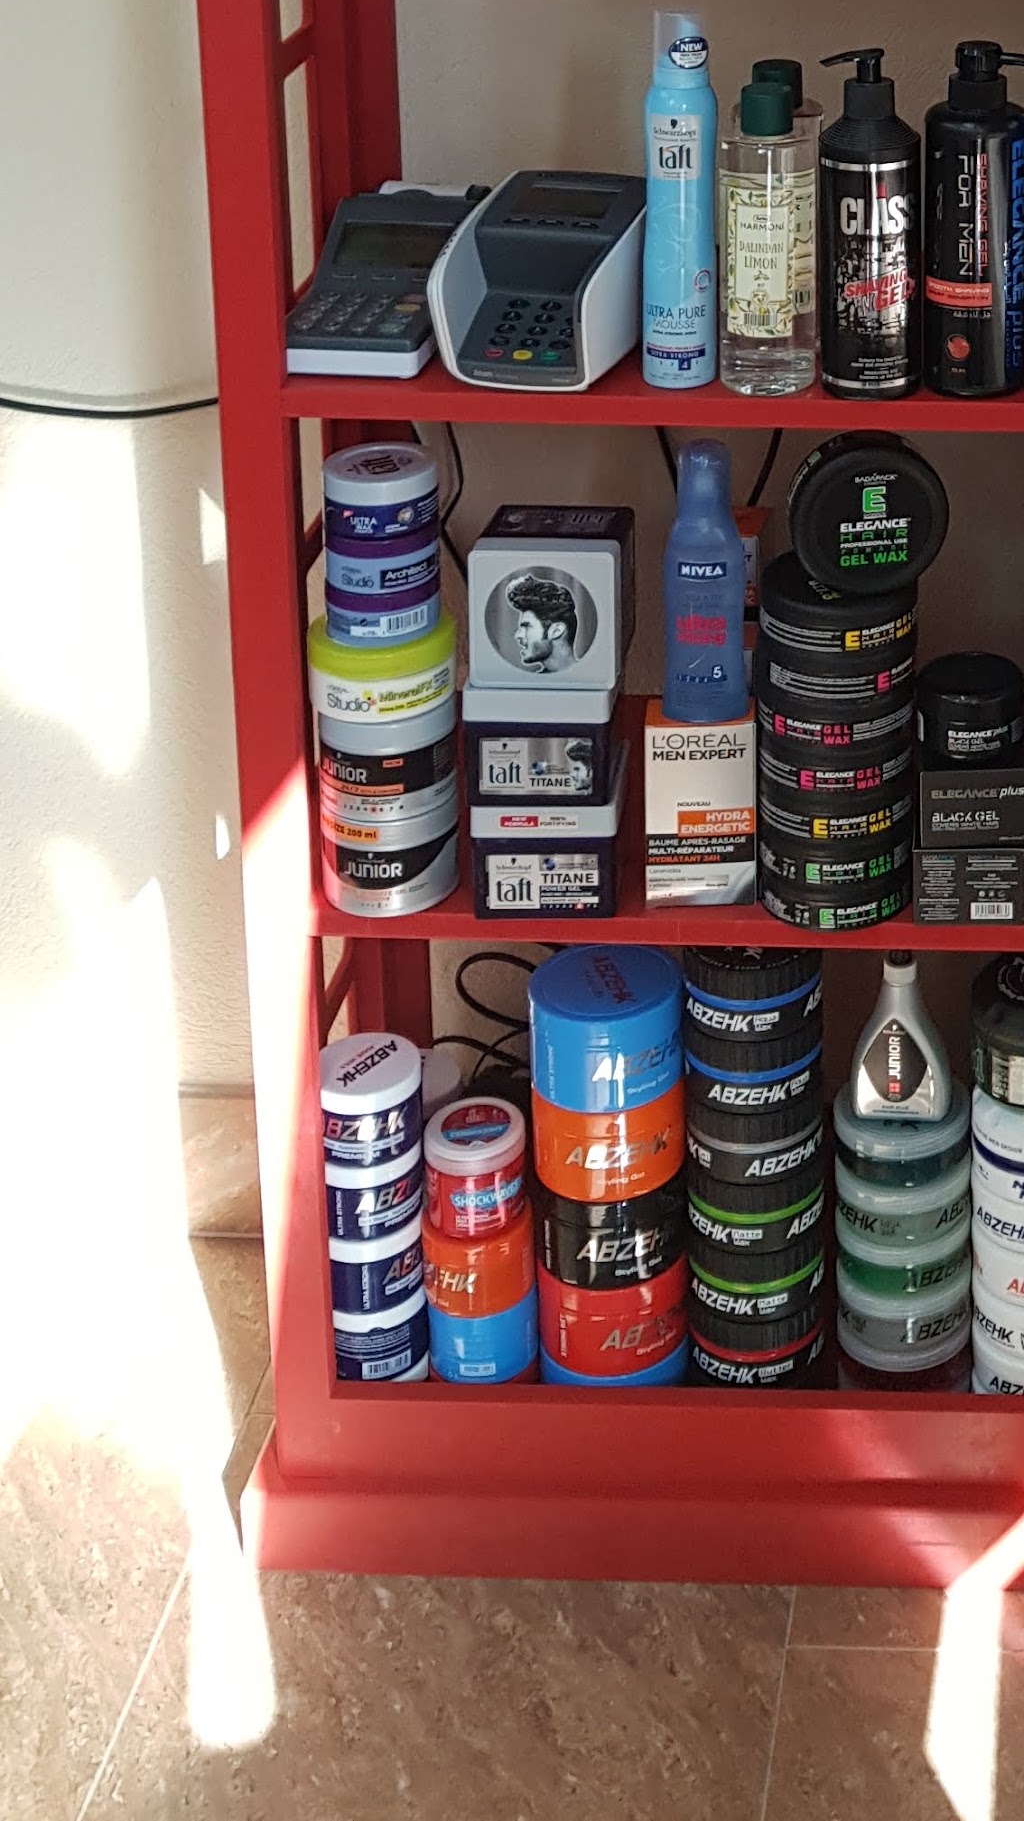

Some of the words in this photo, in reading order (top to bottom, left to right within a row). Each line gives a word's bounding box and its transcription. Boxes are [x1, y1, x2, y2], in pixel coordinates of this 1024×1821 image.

[680, 42, 704, 52] NEW
[658, 143, 693, 170] taft
[958, 154, 974, 208] FOR
[844, 270, 908, 299] SHAVING
[646, 307, 674, 320] ULTRA
[678, 305, 706, 319] PURE
[652, 318, 696, 329] MOUSSE
[840, 517, 908, 533] ELEGANCE
[840, 528, 908, 543] HAIR
[840, 553, 869, 567] GEL
[873, 549, 908, 564] WAX
[386, 561, 428, 580] Architect
[680, 564, 724, 576] NIVEA
[327, 692, 370, 713] Studio
[823, 724, 851, 735] GEL
[948, 730, 992, 739] ELEGANCE
[823, 735, 850, 746] WAX
[652, 750, 686, 761] MEN
[689, 747, 747, 760] EXPERT
[322, 762, 367, 784] JUNIOR
[489, 761, 522, 784] taft
[856, 766, 881, 780] GEL
[530, 777, 572, 787] TITANE
[856, 777, 881, 790] WAX
[931, 787, 998, 799] ELEGANCE
[706, 811, 751, 822] HYDRA
[931, 811, 973, 823] BLACK
[975, 810, 1000, 822] GEL
[681, 822, 751, 835] ENERGETIC
[344, 862, 403, 879] JUNIOR
[541, 873, 595, 884] TITANE
[496, 878, 534, 902] taft
[686, 997, 753, 1032] ABZEHK
[336, 1040, 398, 1088] ABZEHK
[888, 1036, 901, 1080] JUNIOR
[708, 1080, 790, 1106] ABZEHK
[745, 1137, 816, 1177] ABZEHK
[691, 1278, 758, 1316] ABZEHK
[692, 1346, 758, 1384] ABZEHK
